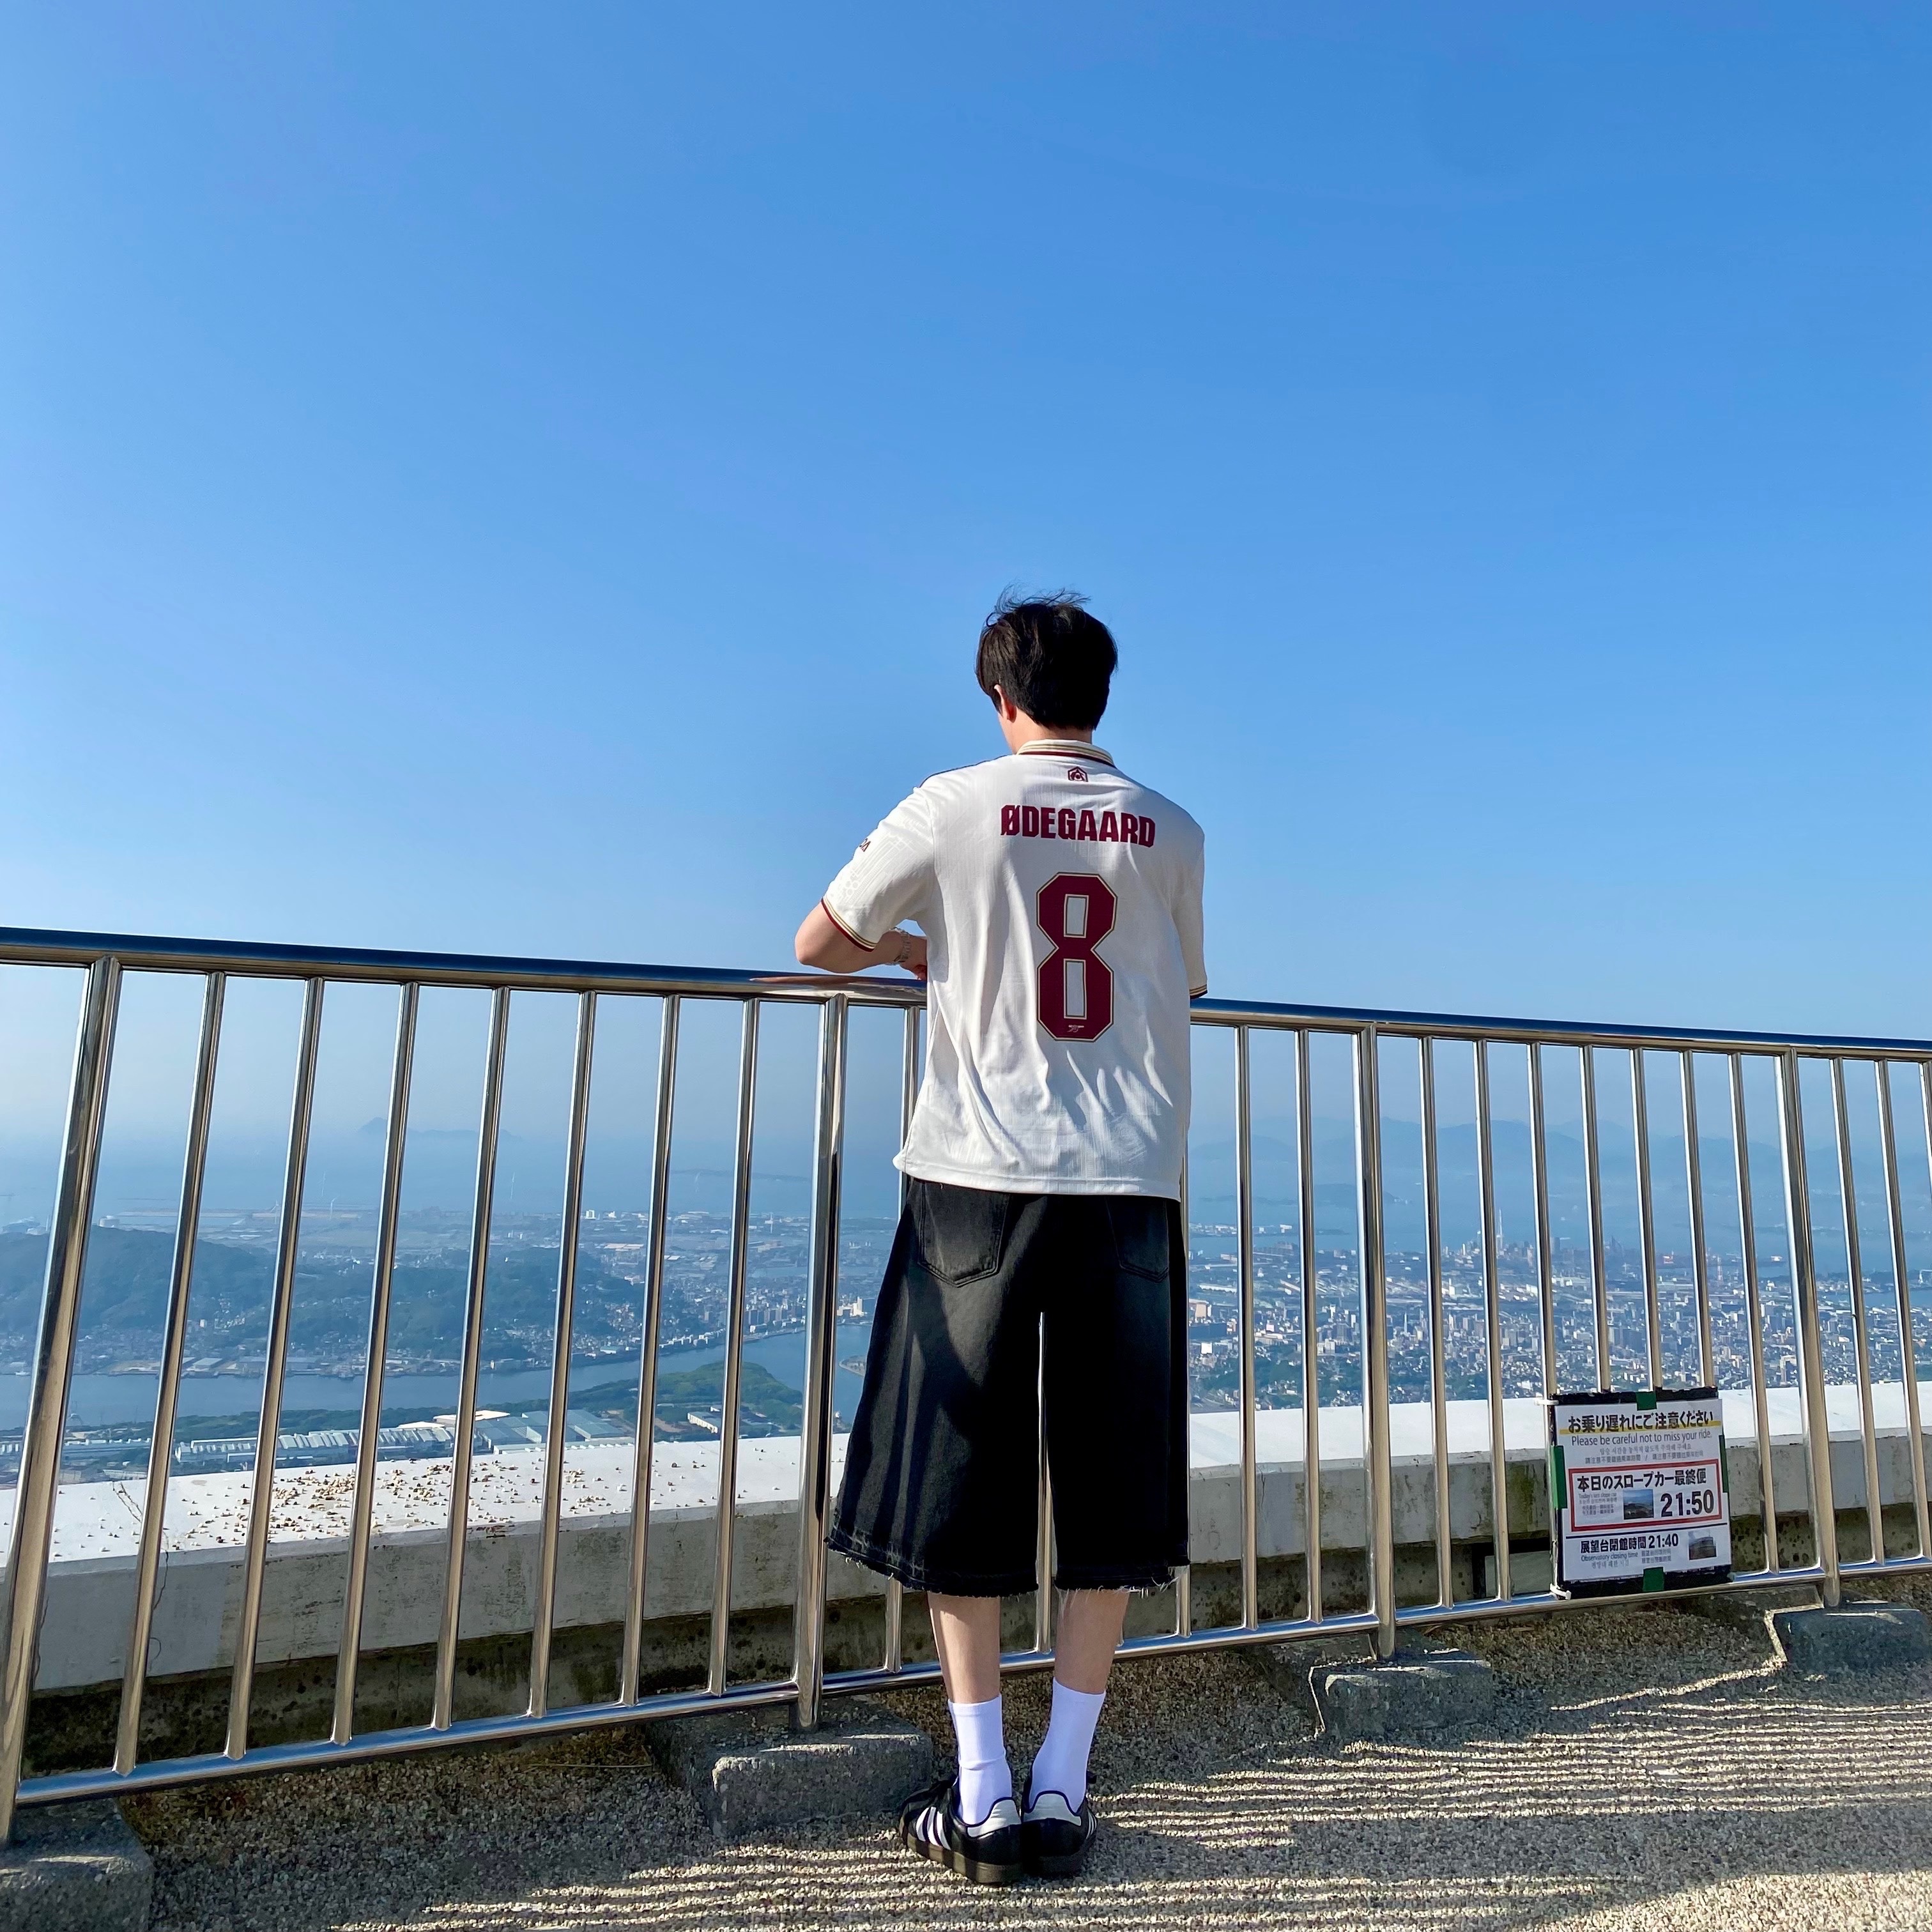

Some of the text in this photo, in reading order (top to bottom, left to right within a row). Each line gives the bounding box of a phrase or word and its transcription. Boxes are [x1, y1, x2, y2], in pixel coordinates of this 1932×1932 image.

[1000, 804, 1156, 848] ØDEGAARD
[1036, 871, 1117, 1043] 8
[1568, 1410, 1713, 1434] お乗り遅れにご注意ください
[1572, 1436, 1598, 1446] Please
[1600, 1435, 1610, 1445] be
[1612, 1433, 1637, 1445] careful
[1639, 1434, 1652, 1443] not
[1654, 1434, 1664, 1442] to
[1664, 1431, 1680, 1441] miss
[1680, 1432, 1697, 1443] your
[1577, 1468, 1706, 1492] 本日のスロープカー最終便
[1660, 1489, 1714, 1517] 21:50
[1581, 1535, 1646, 1554] 展望台閉館時間
[1648, 1533, 1679, 1549] 21:40
